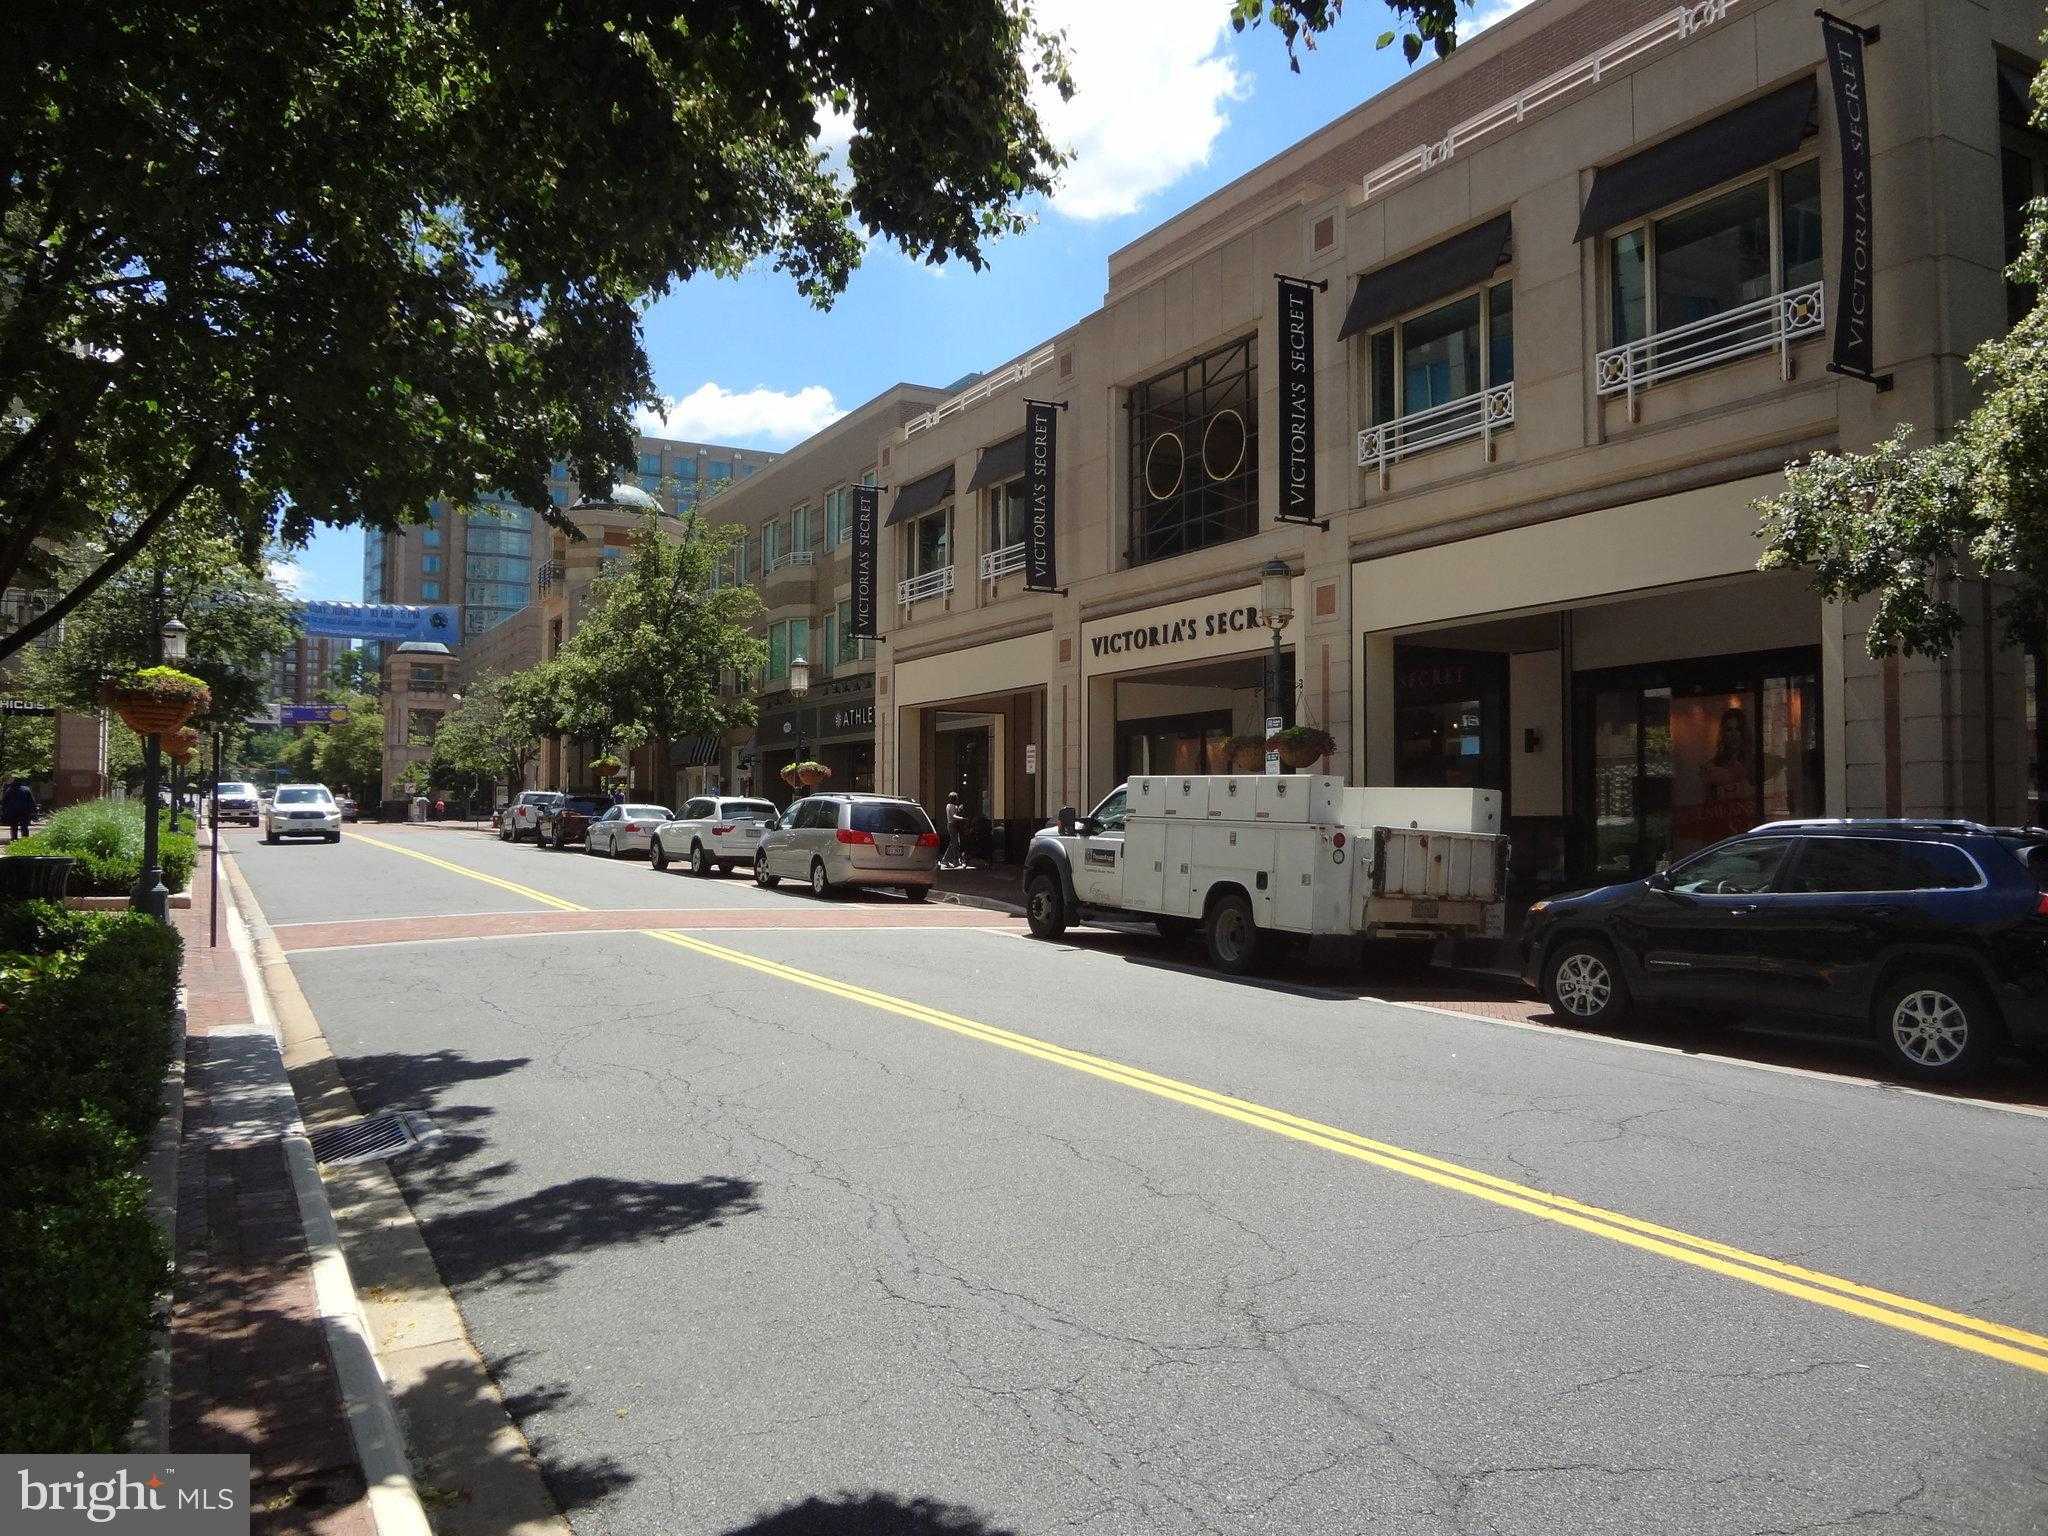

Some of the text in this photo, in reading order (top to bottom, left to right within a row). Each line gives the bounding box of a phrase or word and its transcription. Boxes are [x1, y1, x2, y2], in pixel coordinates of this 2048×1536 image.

[1838, 42, 1867, 350] VICTORIA'S SECRET
[1289, 293, 1306, 506] VICTORIA'S SECRET
[857, 496, 871, 628] VICTORIA'S SECRET
[1033, 412, 1048, 578] VICTORIA'S SECRET
[1091, 606, 1266, 658] VICTORIA'S SECR
[843, 706, 877, 726] ATHLE
